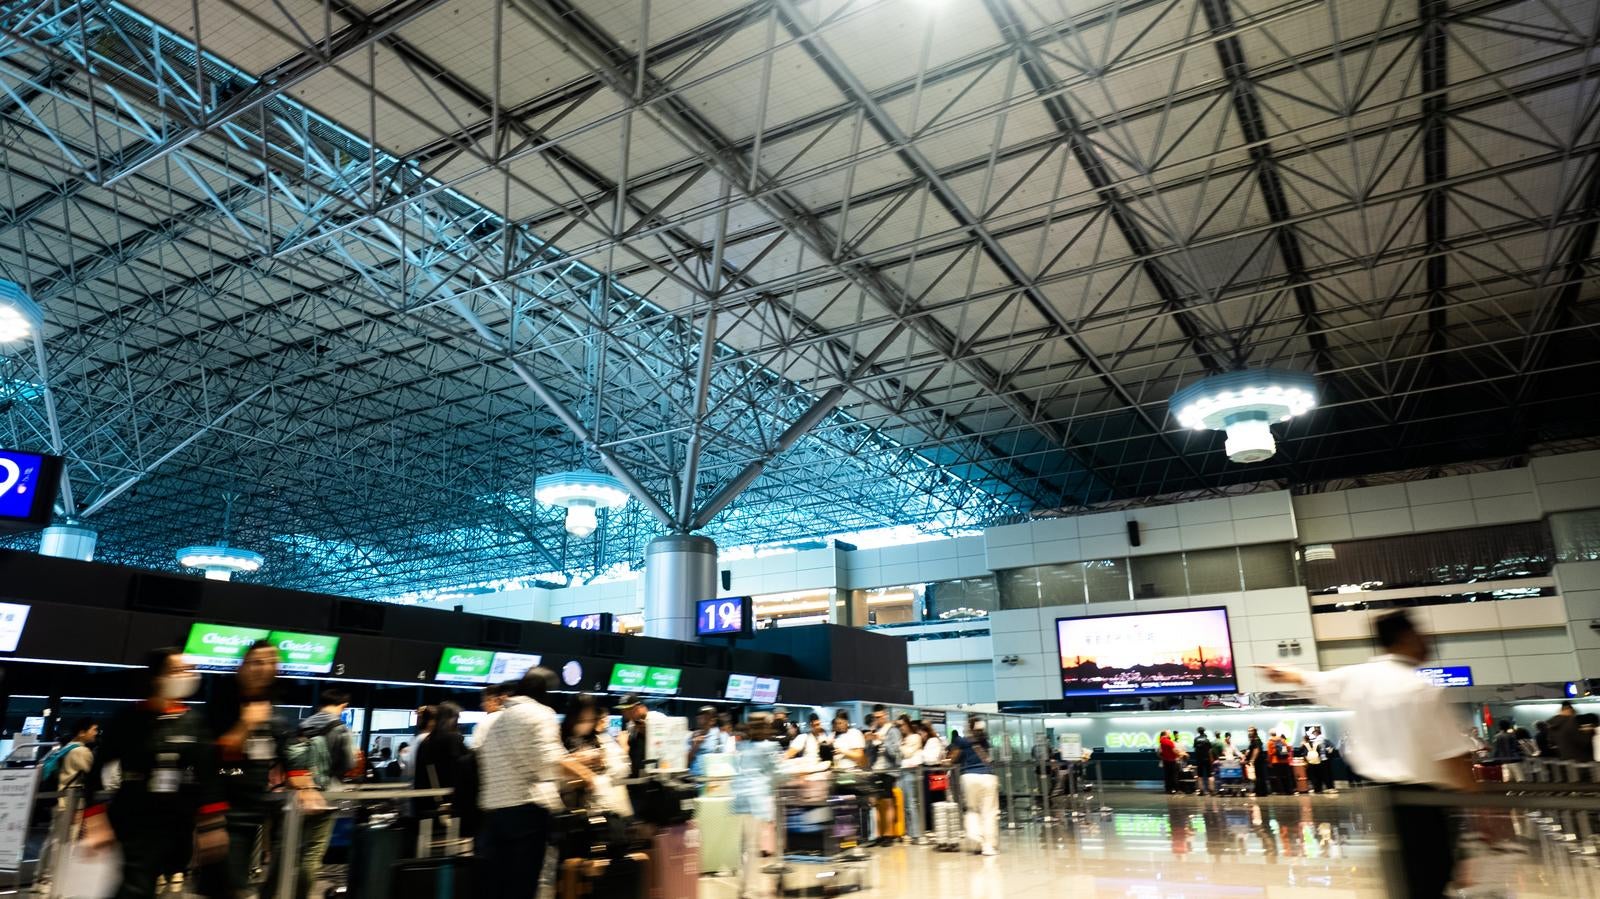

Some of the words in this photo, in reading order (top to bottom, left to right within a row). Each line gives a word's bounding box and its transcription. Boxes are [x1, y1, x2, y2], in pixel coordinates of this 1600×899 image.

[704, 602, 735, 630] 19
[335, 664, 345, 675] 3
[417, 670, 426, 680] 4
[1105, 732, 1153, 747] EVA
